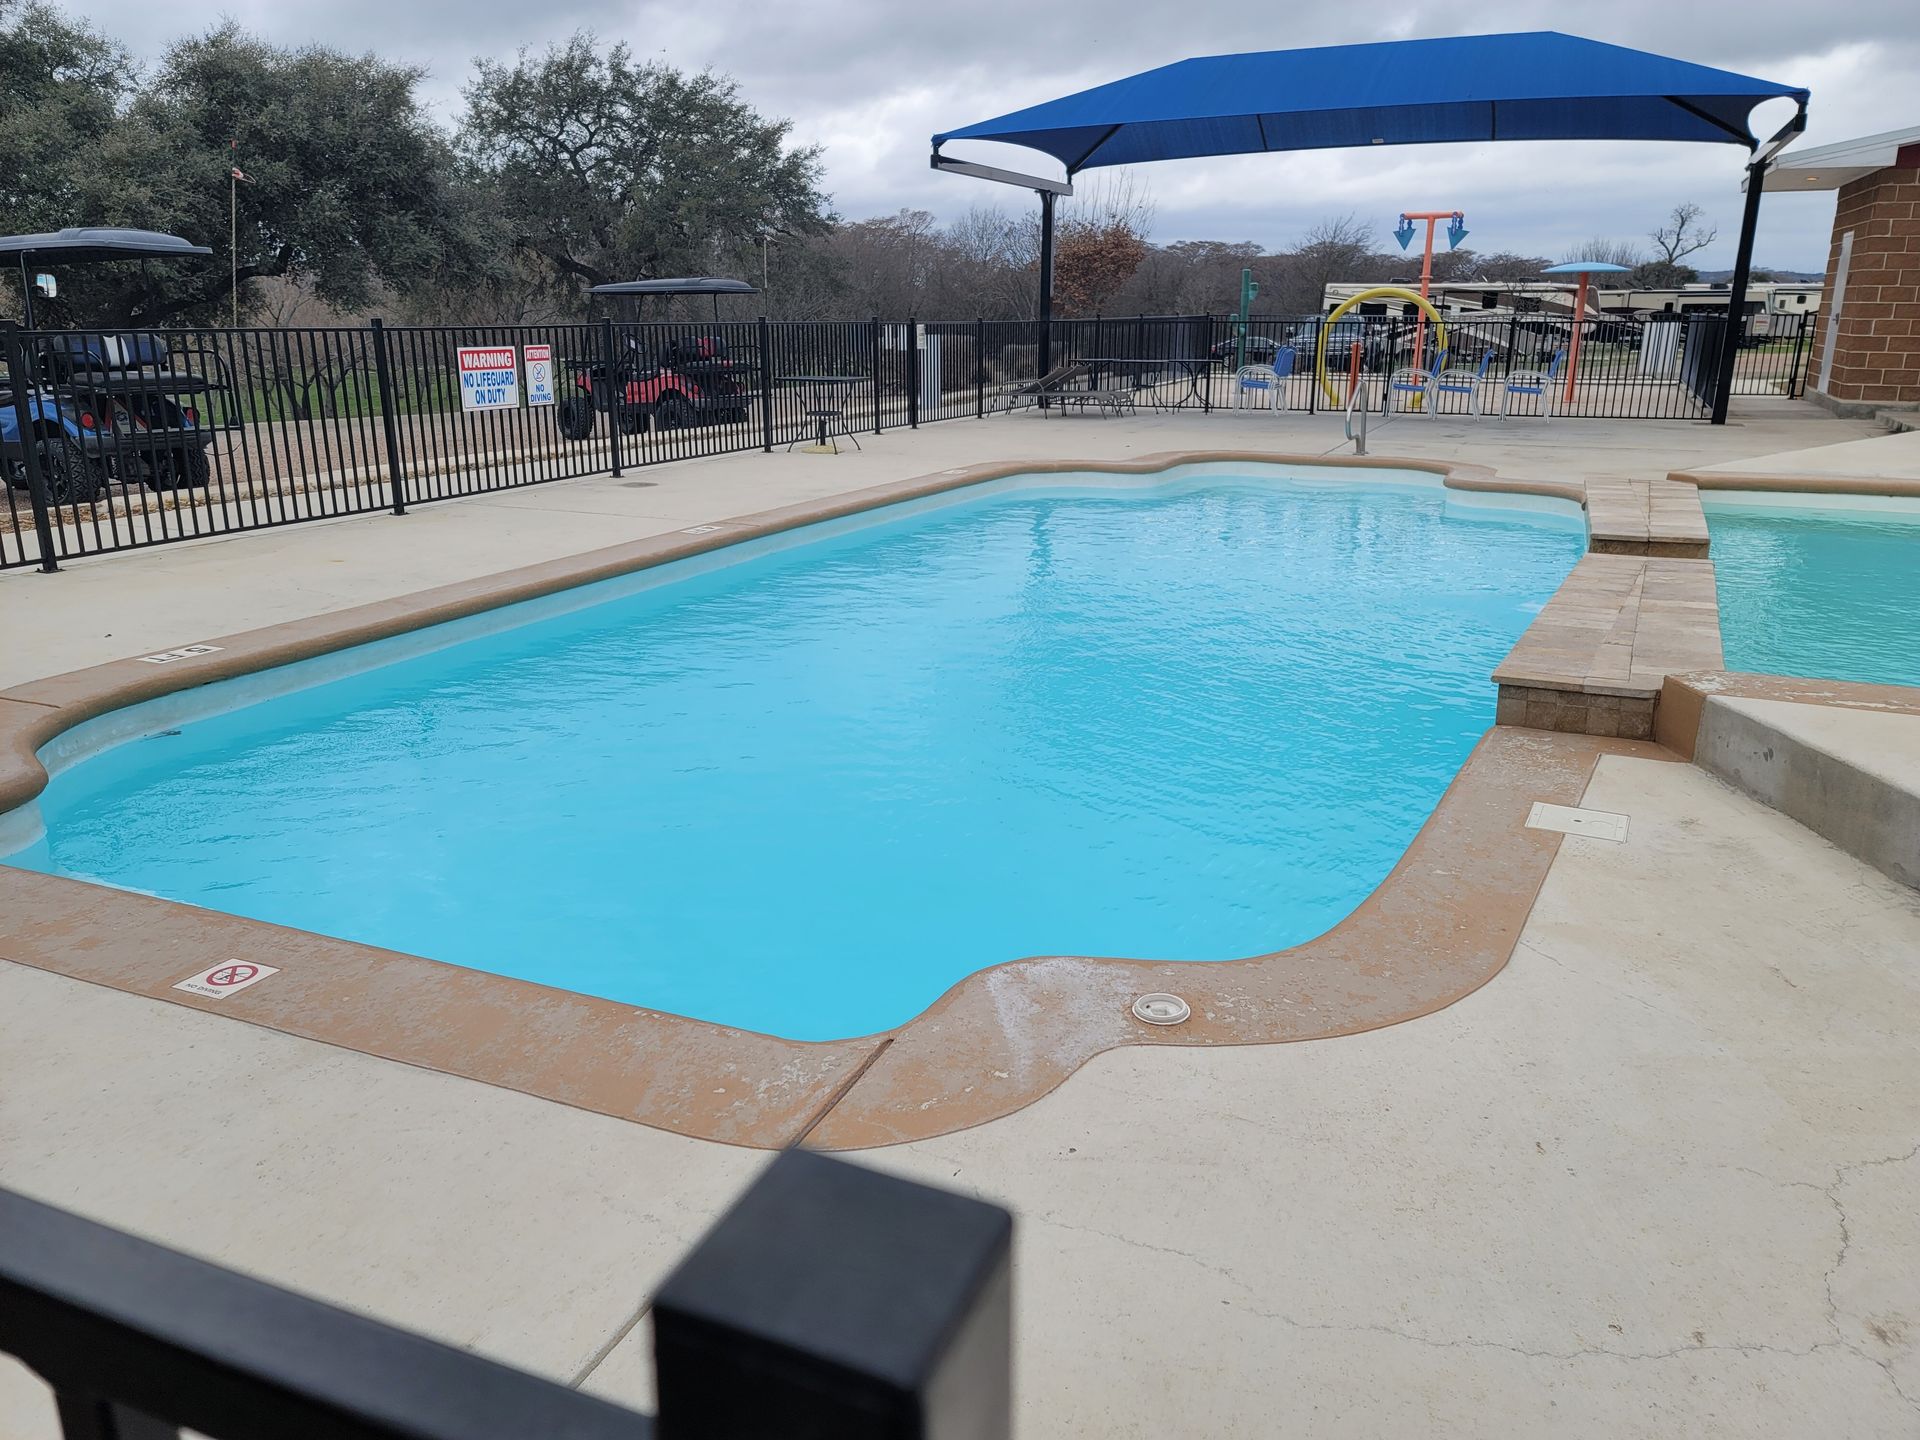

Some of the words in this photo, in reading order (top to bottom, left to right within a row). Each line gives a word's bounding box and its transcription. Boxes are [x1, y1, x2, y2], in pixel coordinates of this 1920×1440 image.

[526, 349, 549, 359] ATTENTION
[462, 352, 512, 368] WARNING
[463, 373, 474, 388] NO
[476, 371, 514, 387] LIFEGUARD
[535, 384, 545, 393] NO
[475, 389, 486, 404] ON
[487, 388, 506, 404] DUTY
[530, 393, 552, 402] DIVING
[147, 654, 184, 662] FT
[198, 986, 222, 995] DIVING
